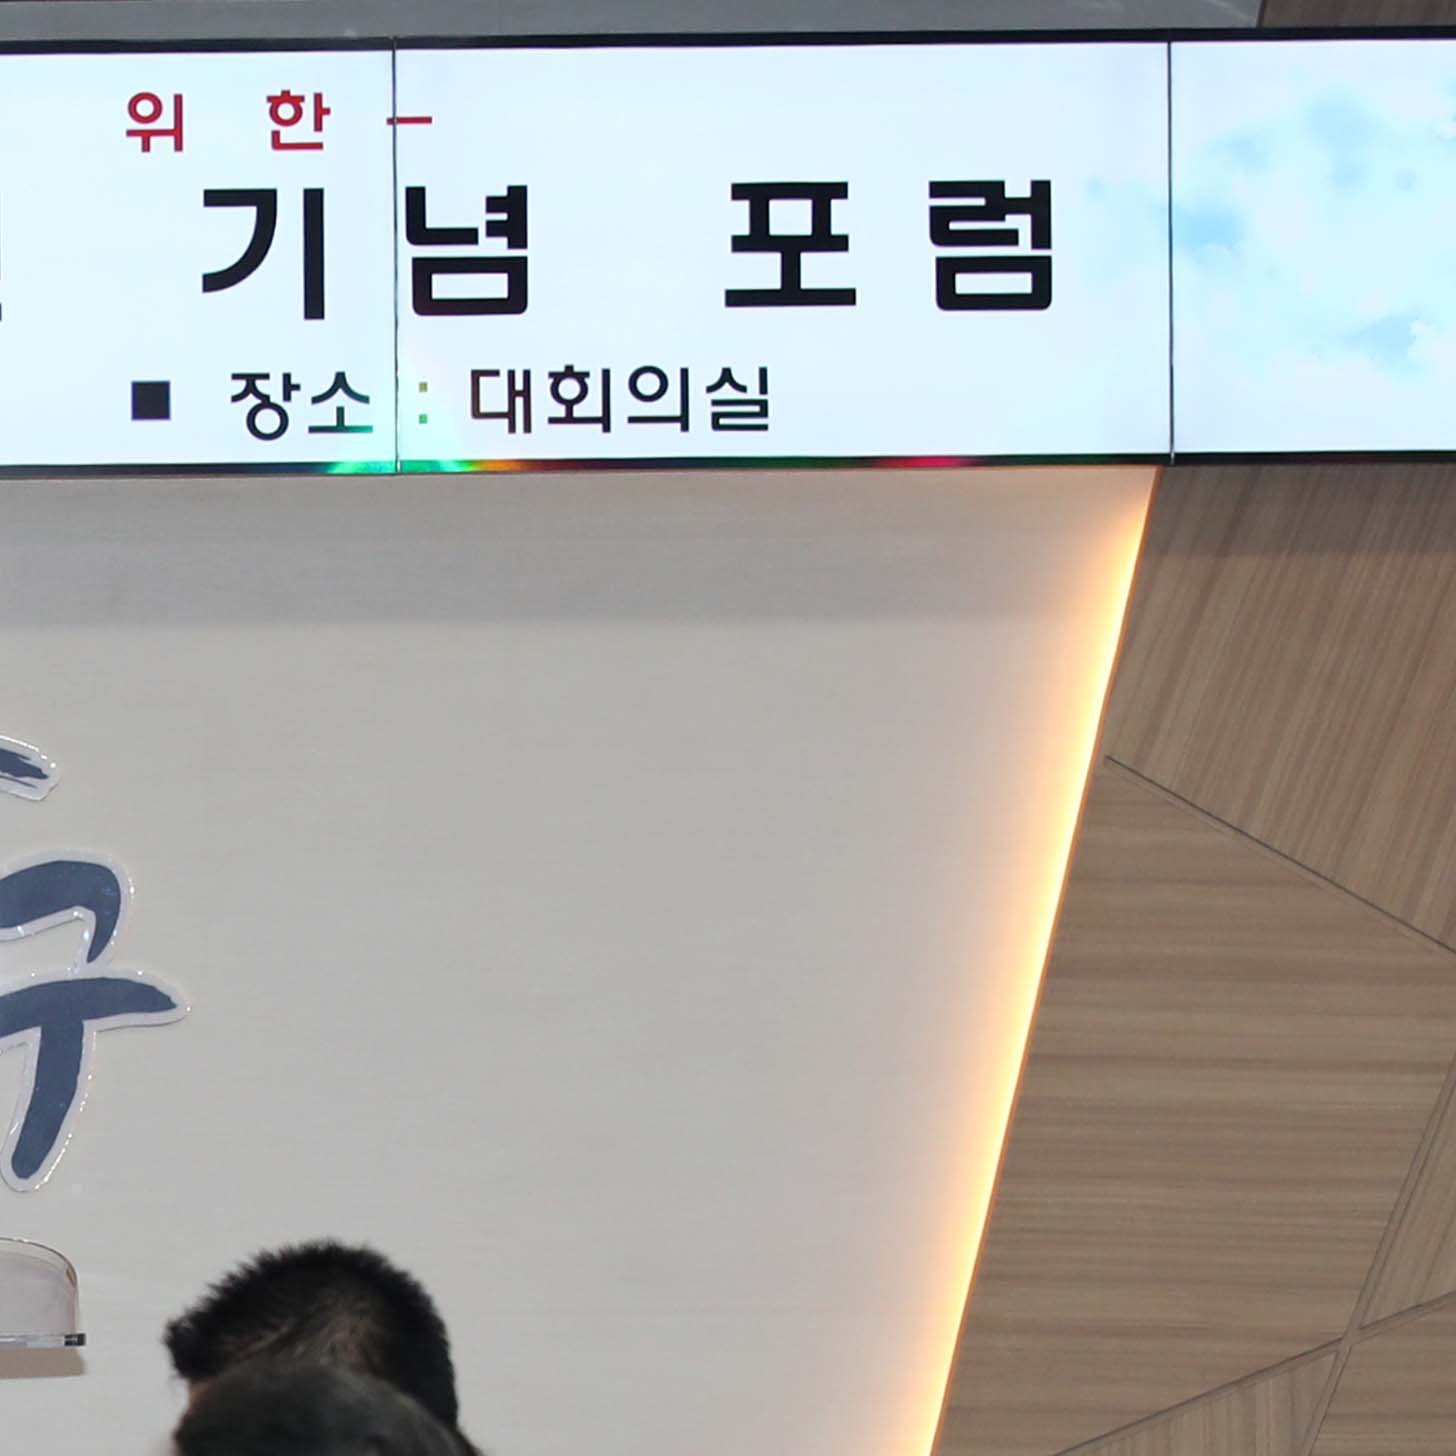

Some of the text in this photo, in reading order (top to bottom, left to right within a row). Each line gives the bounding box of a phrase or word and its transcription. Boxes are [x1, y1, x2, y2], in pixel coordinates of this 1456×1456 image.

[201, 184, 529, 321] 기념
[724, 179, 1053, 312] 포럼
[230, 370, 374, 442] 장소
[470, 364, 770, 435] 대회의실
